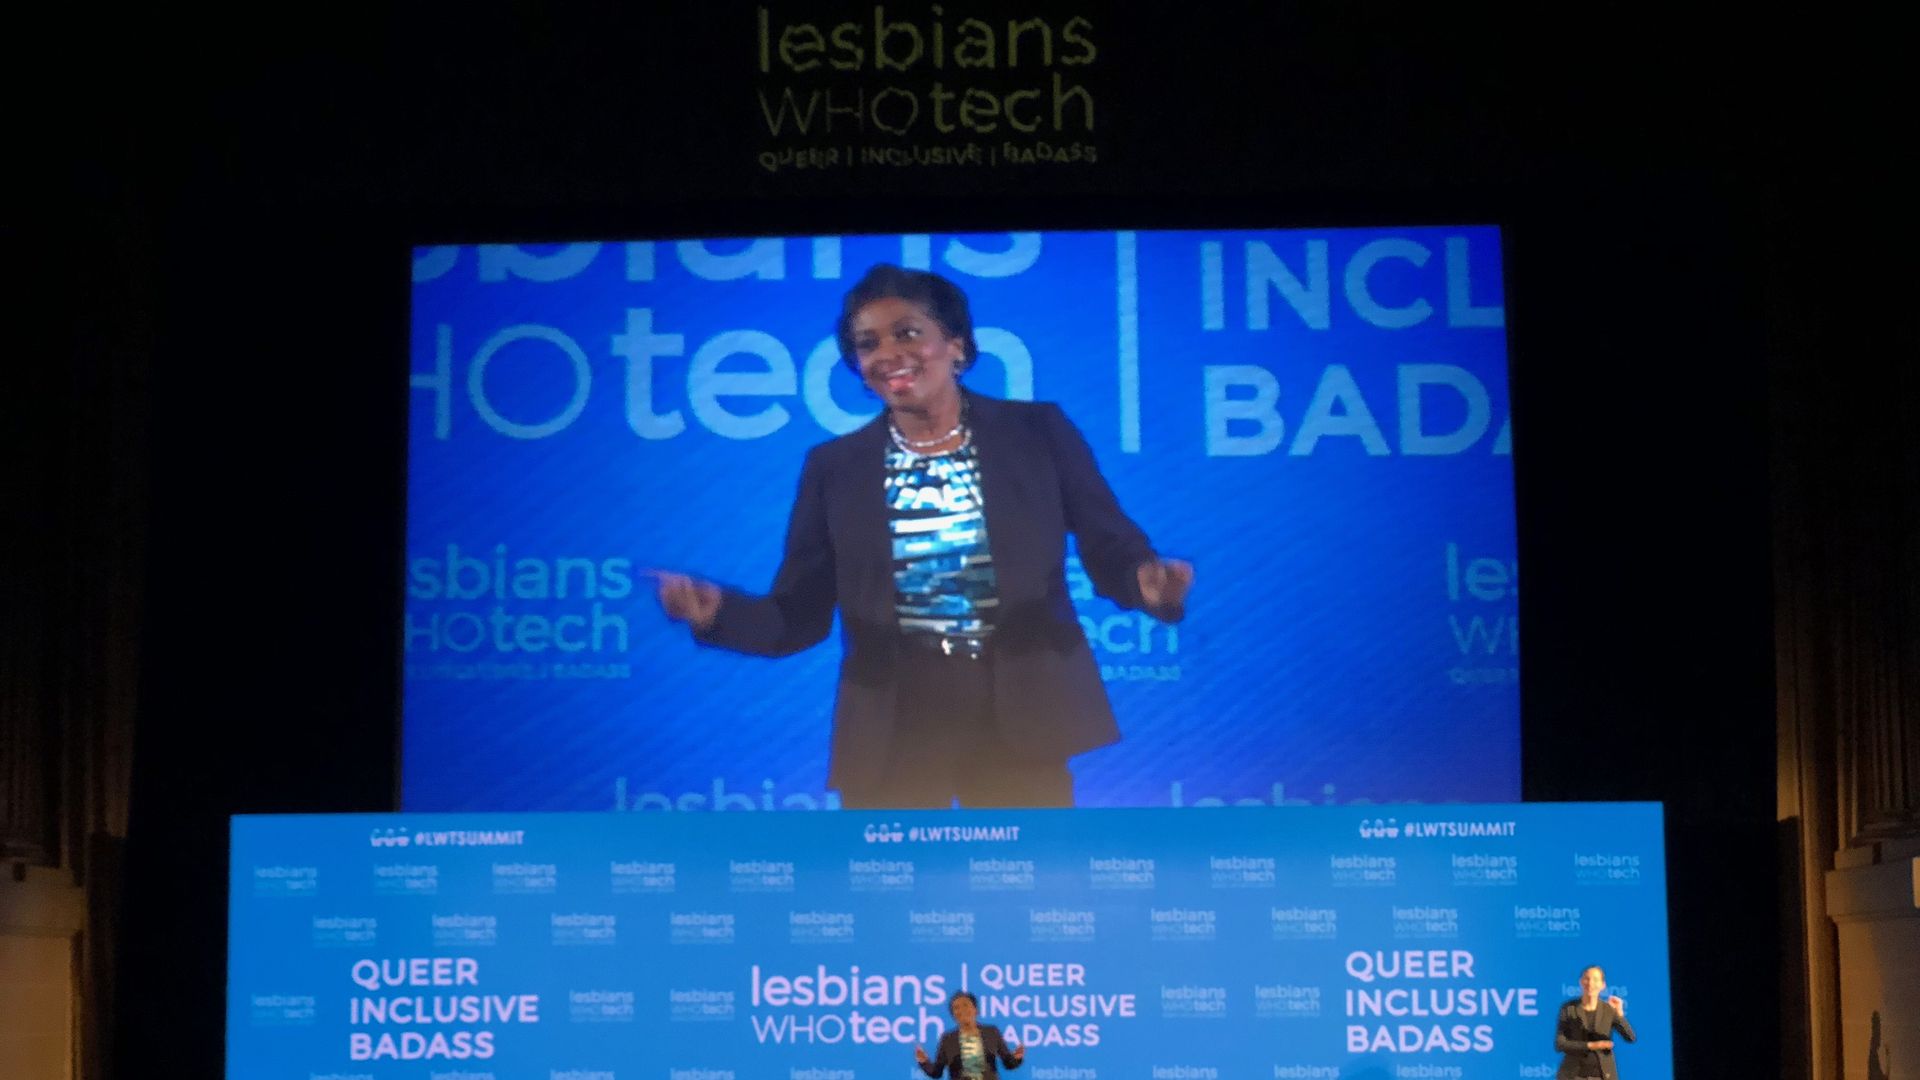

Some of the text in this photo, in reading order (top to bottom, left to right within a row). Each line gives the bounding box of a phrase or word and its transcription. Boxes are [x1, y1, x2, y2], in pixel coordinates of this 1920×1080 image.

[757, 4, 1098, 74] lesbians
[758, 139, 1098, 172] QUEER INCLUSIVE BADASS
[1200, 236, 1504, 331] INCL
[1203, 361, 1512, 457] BAD
[909, 825, 1021, 842] #LWTSUMMIT
[1404, 821, 1516, 838] #LWTSUMMIT
[415, 830, 525, 846] #LWTSUMMIT
[850, 860, 914, 873] lesbians
[969, 859, 1034, 872] lesbians
[1090, 858, 1154, 871] lesbians
[1210, 856, 1275, 869] lesbians
[1331, 855, 1396, 868] lesbians
[1452, 854, 1518, 867] lesbians
[1574, 854, 1640, 867] lesbians
[790, 912, 854, 925] lesbians
[910, 911, 975, 924] lesbians
[1030, 910, 1095, 923] lesbians
[1151, 909, 1216, 922] lesbians
[1272, 908, 1337, 921] lesbians
[1393, 907, 1459, 920] lesbians
[1515, 906, 1580, 919] lesbians
[1345, 949, 1475, 982] QUEER
[351, 957, 479, 991] QUEER
[980, 962, 1086, 990] QUEER
[751, 964, 947, 1006] lesbians
[1562, 982, 1628, 997] lesans
[570, 991, 634, 1004] lesbians
[670, 990, 735, 1003] lesbians
[1161, 986, 1226, 999] lesbians
[1255, 986, 1320, 999] lesbians
[980, 993, 1136, 1018] INCLUSIVE
[1345, 987, 1539, 1017] INCLUSIVE
[350, 994, 540, 1025] INCLUSIVE
[1001, 1023, 1100, 1048] ADASS
[1346, 1024, 1495, 1054] BADASS
[350, 1031, 495, 1061] BADASS
[1031, 1066, 1096, 1079] lesbians
[1153, 1065, 1217, 1079] lesbians
[1274, 1064, 1340, 1078] lesbians
[1397, 1064, 1462, 1078] lesbians
